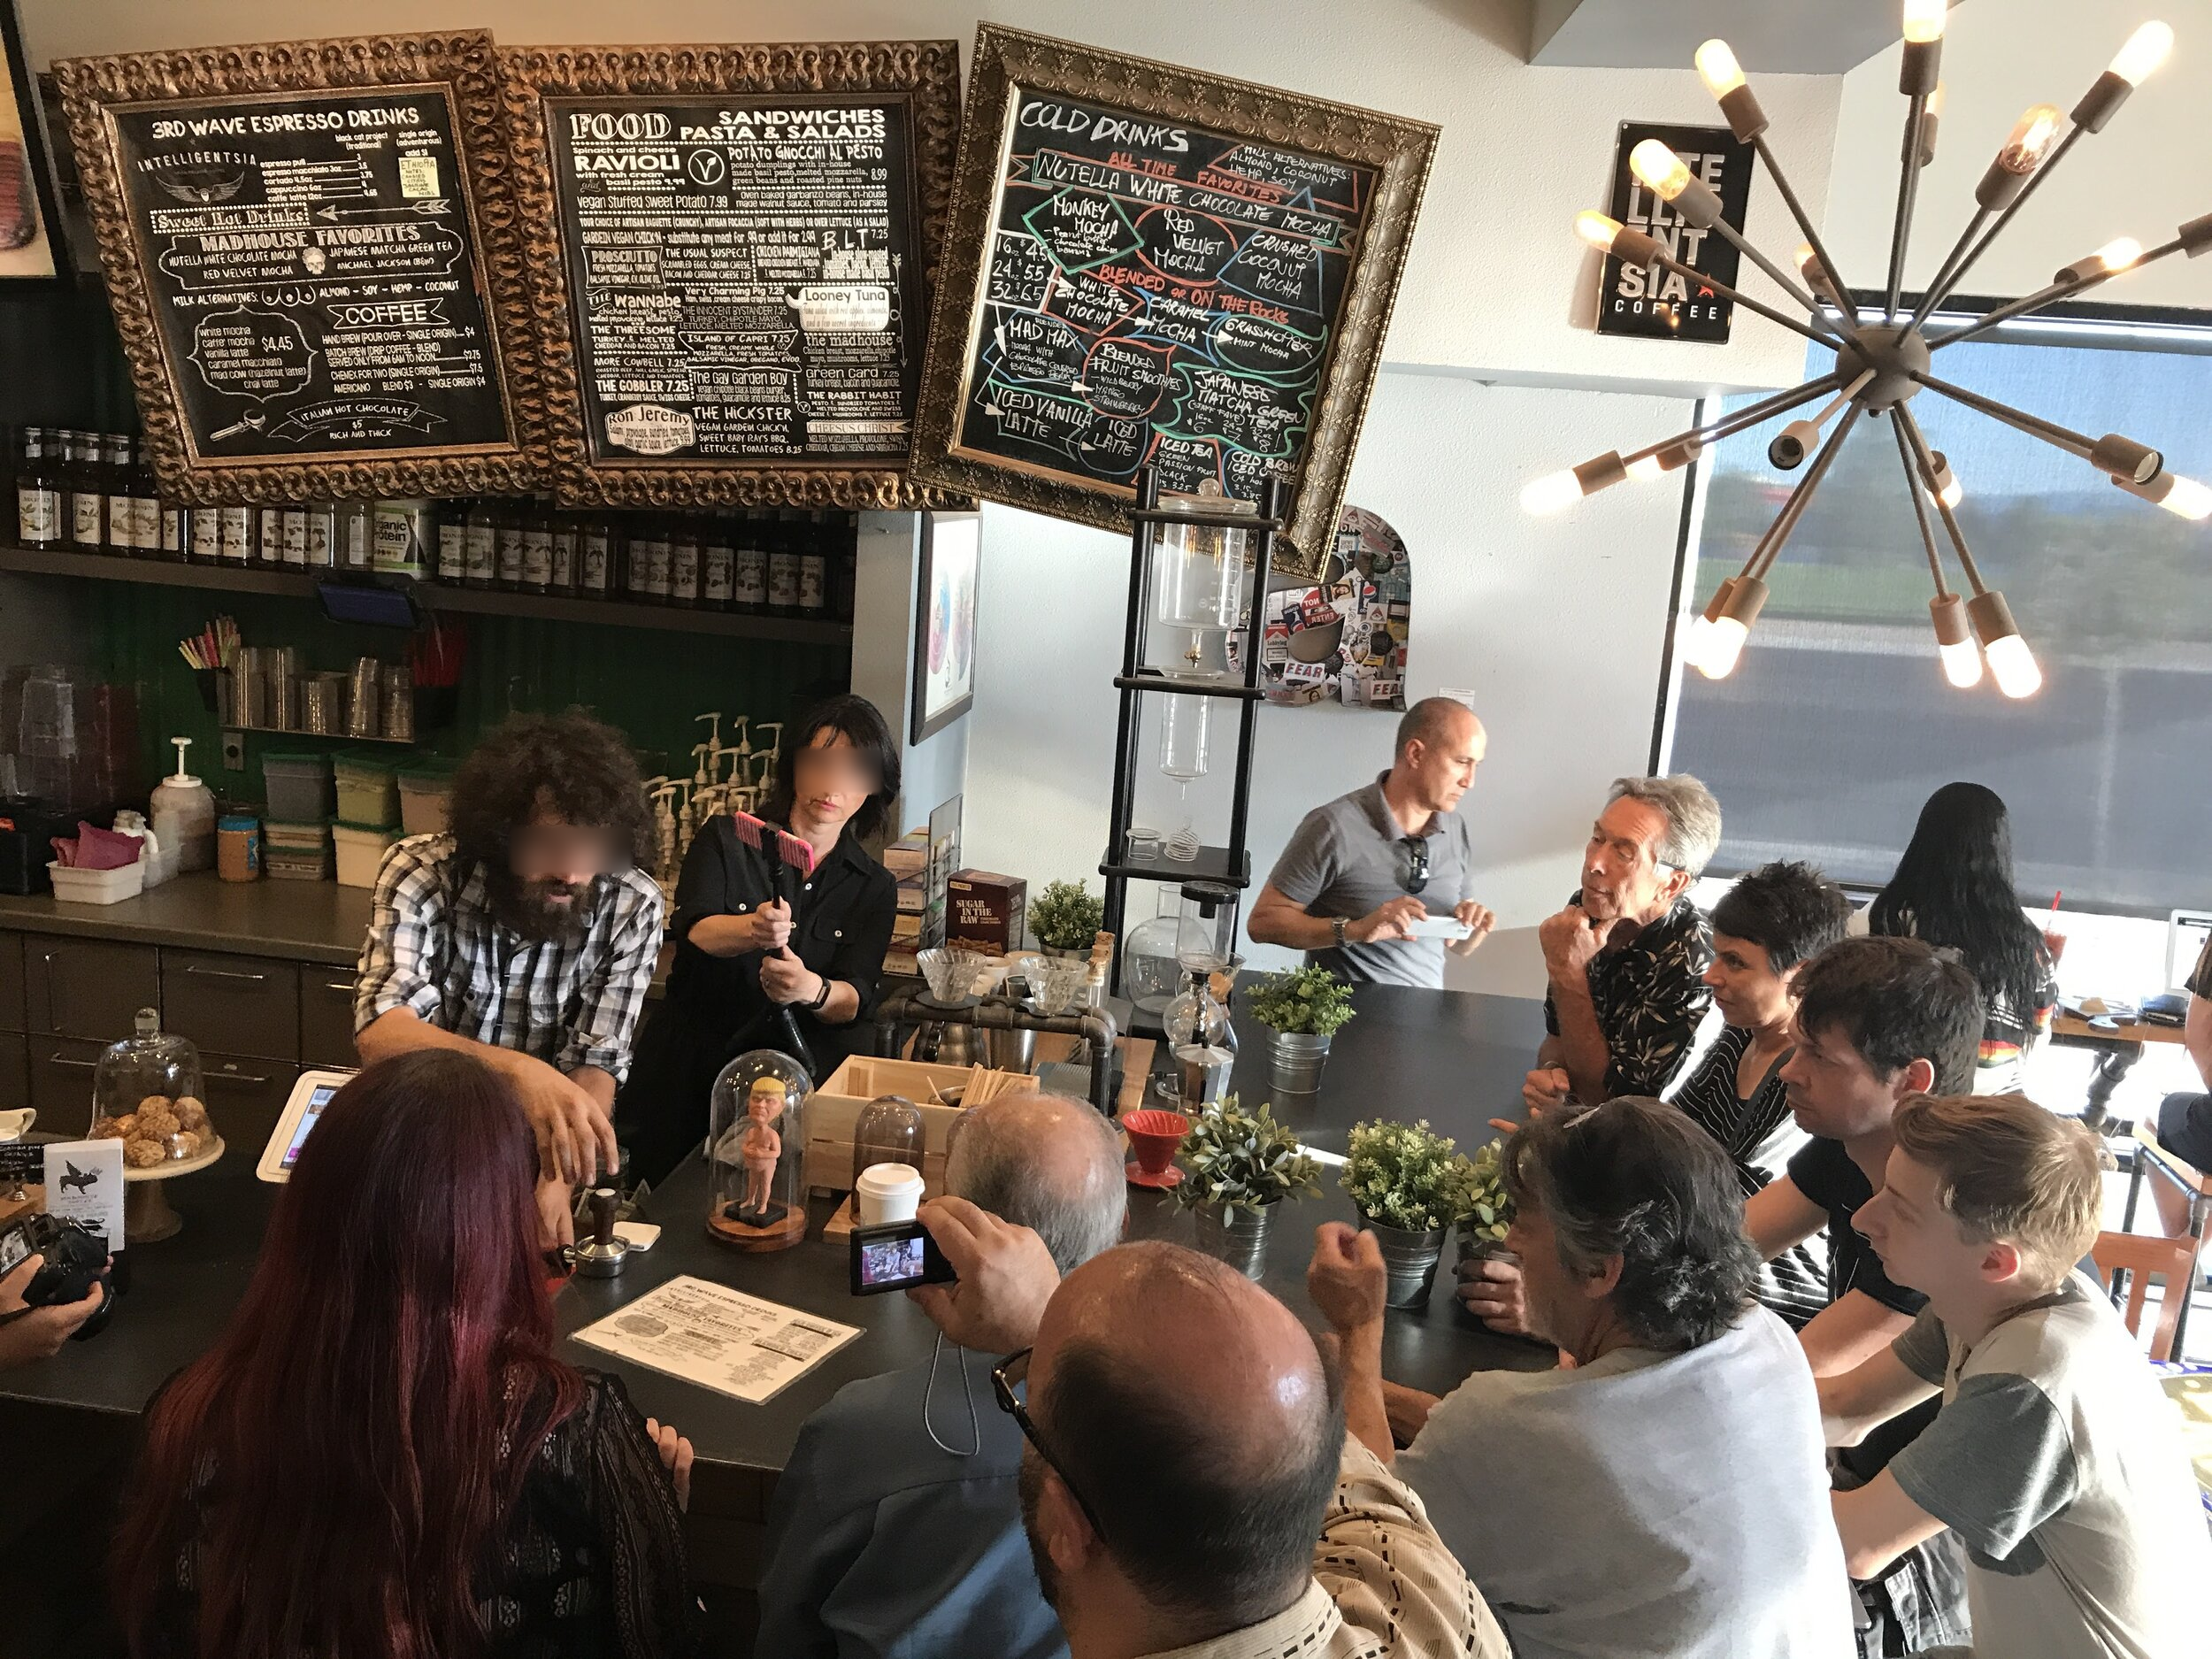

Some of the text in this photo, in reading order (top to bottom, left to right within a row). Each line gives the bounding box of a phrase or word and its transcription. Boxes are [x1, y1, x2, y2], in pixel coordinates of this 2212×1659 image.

[151, 107, 419, 139] 3RD WAVE ESPRESSO DRINKS
[569, 112, 672, 140] FOOD
[718, 109, 885, 126] SANDWICHES
[1020, 102, 1189, 151] COLD DRINKS
[680, 124, 886, 141] PASTA & SALADS
[137, 151, 257, 173] INTELLIGENTSIA
[727, 143, 883, 161] POTATO GNOCCHI AL PESTO
[292, 158, 306, 167] pull
[573, 154, 680, 172] RAVIOLI
[756, 160, 796, 169] dumplings
[1108, 151, 1179, 176] ALL TIME
[265, 185, 308, 194] cappuccino
[1037, 155, 1331, 238] NUTELLA WHITE CHOCOLATE MOCHA
[1197, 171, 1282, 204] FAVORITES
[1053, 195, 1110, 220] MONKEY
[157, 208, 303, 229] Sweet Hot Drinks
[1075, 217, 1118, 239] MOCHA
[1164, 208, 1194, 234] RED
[199, 225, 421, 252] MADHOUSE FAVORITES
[1172, 234, 1225, 257] VELVET
[1251, 234, 1317, 262] CRUSHED
[169, 250, 297, 267] NUTELLA WHITE CHOCOLATE MOCHA
[328, 241, 453, 257] JAPANESE MATCHA GREEN TEA
[665, 248, 748, 257] THE USUAL SUSPECT
[1154, 247, 1206, 273] MOCHA
[1237, 250, 1307, 280] COCONUT
[203, 265, 294, 280] RED VELVET MOCHA
[1617, 261, 1688, 302] SIA
[362, 280, 459, 296] SOY COCONUT
[685, 287, 706, 296] Very
[709, 287, 750, 297] Charming
[752, 287, 766, 297] Pig
[804, 288, 886, 304] Looney Tuna
[1098, 264, 1165, 292] BLENDED
[1191, 290, 1215, 307] ON
[1218, 295, 1248, 312] THE
[172, 292, 258, 306] MILK ALTERNATIVES:
[1149, 296, 1210, 322] CARAMEL
[1615, 299, 1717, 319] COFFEE
[344, 303, 428, 325] COFFEE
[199, 326, 251, 337] white mocha
[590, 326, 676, 334] THE THREESOME
[687, 334, 721, 343] ISLAND
[739, 334, 768, 343] CAPRI
[1010, 317, 1079, 350] MAD MAX
[1225, 319, 1313, 358] GRASSHOPPER
[262, 335, 294, 353] $4.45
[806, 335, 894, 346] the madhouse
[334, 380, 414, 394] AMERICANO BLEND $3
[595, 380, 689, 392] THE GOBBLER 7.25
[1194, 370, 1279, 402] JAPANESE
[300, 403, 410, 423] ITALIAN HOT CHOCOLATE
[609, 406, 689, 426] Ron Jeremy
[995, 387, 1094, 429] ICED VANILLA
[1004, 409, 1052, 438] LATTE
[1108, 419, 1138, 439] ICED
[700, 445, 739, 454] LETTUCE,
[786, 445, 803, 454] 8.25
[1093, 433, 1138, 457] LATTE
[1160, 437, 1214, 459] ICED TEA
[372, 519, 407, 532] rganic
[372, 530, 407, 541] rotein
[1285, 664, 1323, 679] FEAR
[956, 899, 986, 908] SUGAR
[972, 908, 992, 917] THE
[960, 916, 979, 925] RAW
